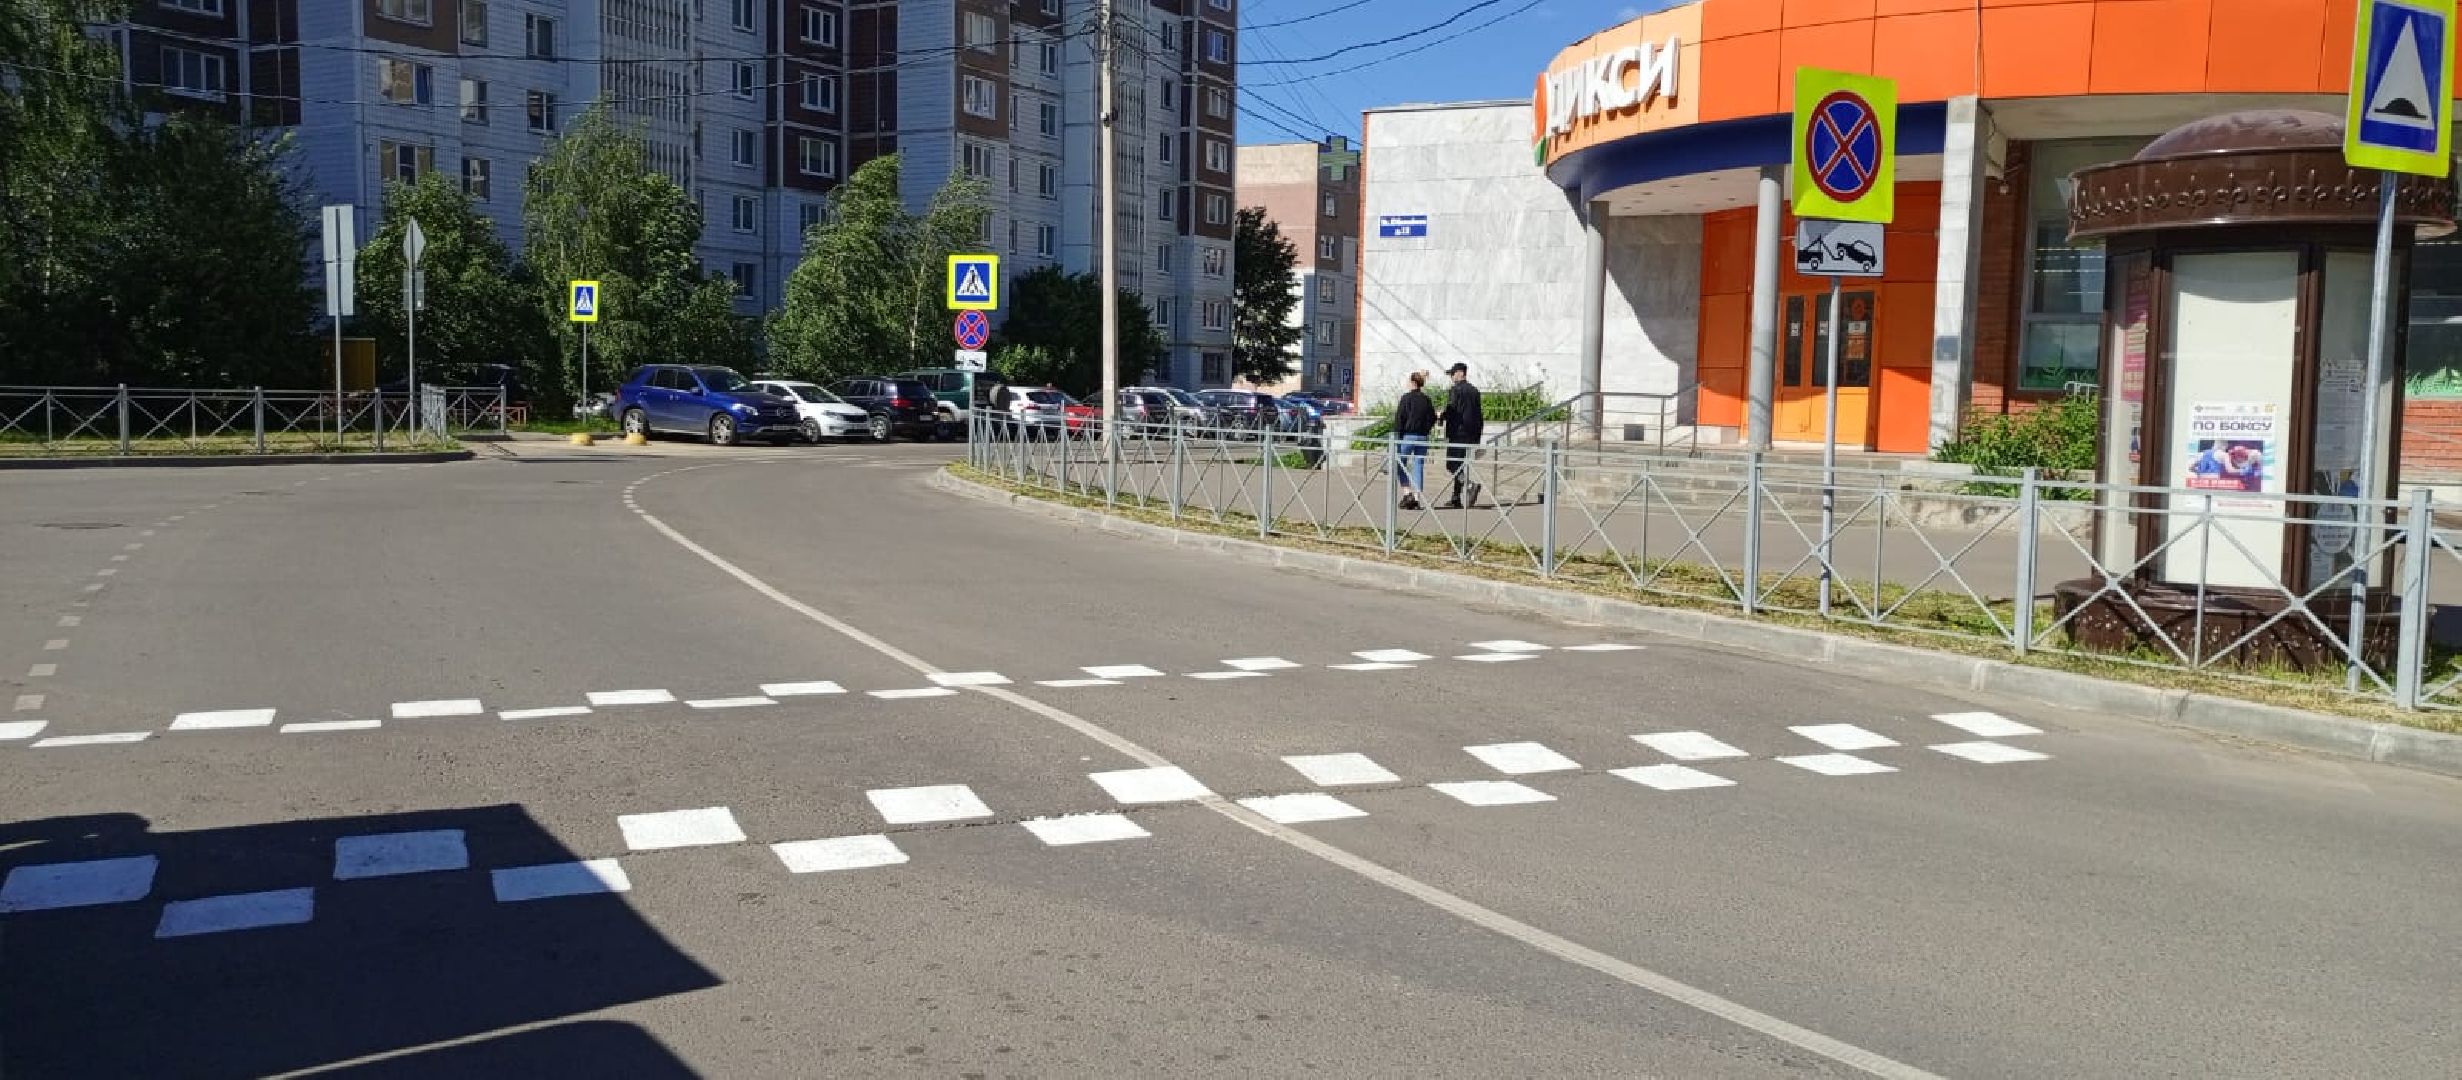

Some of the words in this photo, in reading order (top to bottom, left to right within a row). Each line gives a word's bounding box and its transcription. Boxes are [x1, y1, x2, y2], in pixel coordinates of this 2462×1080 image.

[1546, 35, 1680, 137] ДИКСИ
[2193, 421, 2215, 431] ПО
[2220, 422, 2272, 431] БОКСУ
